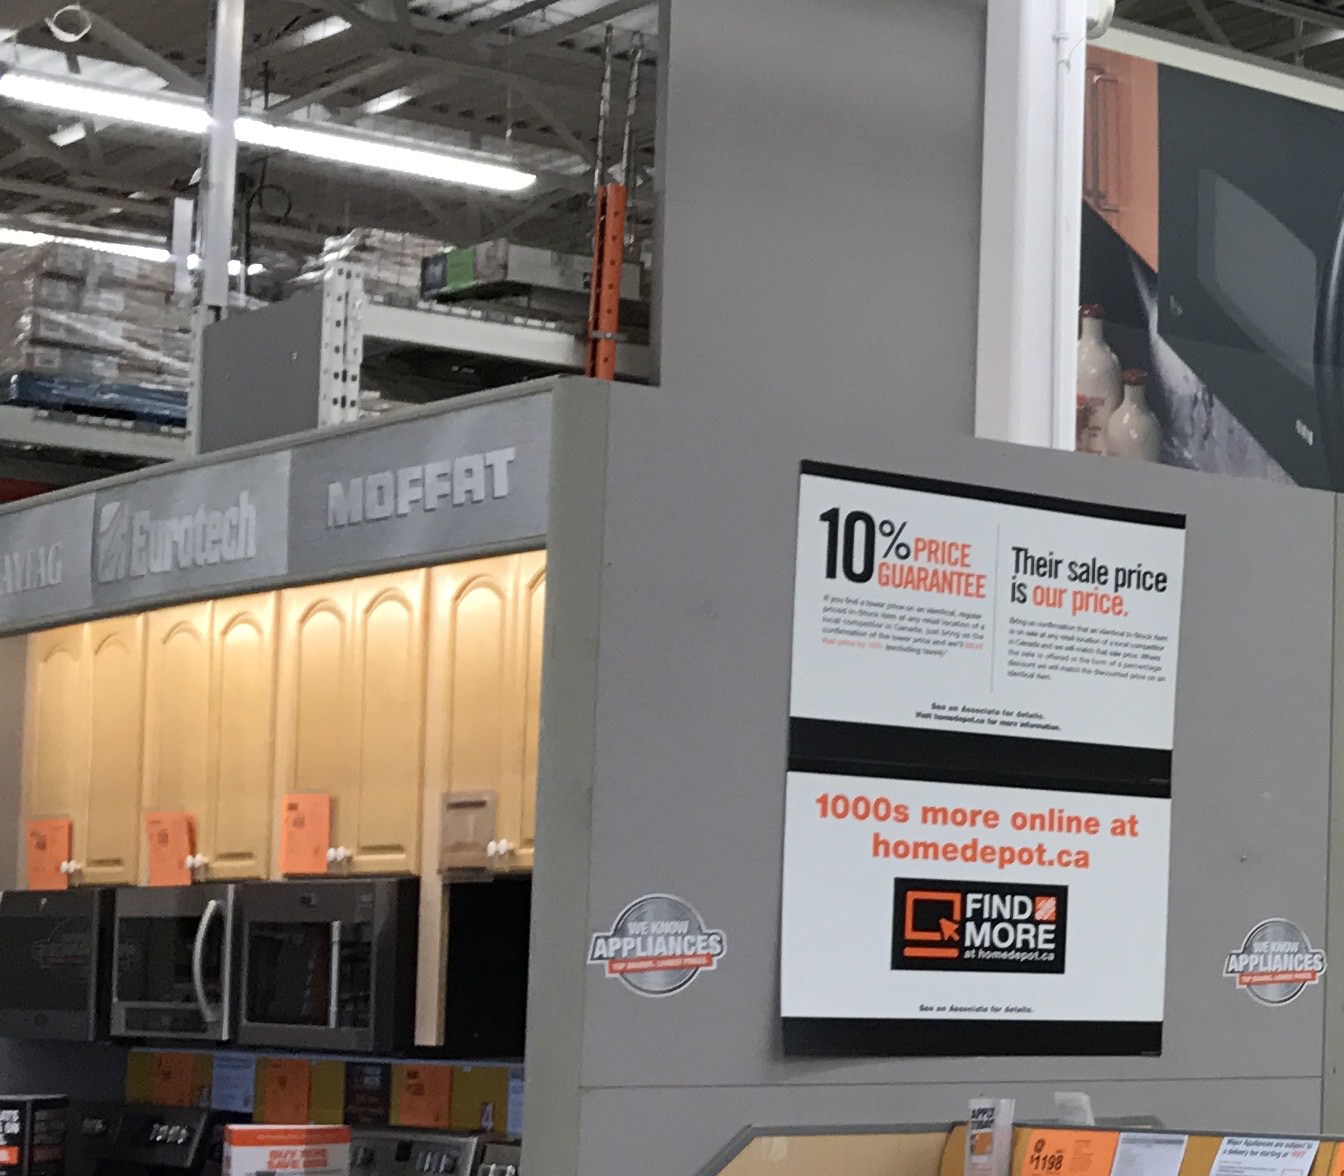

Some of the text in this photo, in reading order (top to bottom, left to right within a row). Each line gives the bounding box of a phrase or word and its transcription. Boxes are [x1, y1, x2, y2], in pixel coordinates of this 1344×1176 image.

[327, 447, 516, 528] MOFFAT
[130, 490, 258, 576] Eurotech
[819, 506, 971, 584] 10% PRICE
[877, 561, 987, 599] GUARANTEE
[1011, 545, 1168, 593] Their sale price
[1010, 575, 1129, 617] is our price.
[816, 793, 1139, 838] 1000s more online at
[872, 832, 1090, 869] homedepot.ca
[965, 892, 1033, 921] FIND
[593, 935, 721, 959] APPLIANCES
[964, 922, 1056, 949] MORE
[964, 948, 1056, 963] at homedepot.ca
[1228, 954, 1323, 972] APPLIANCES
